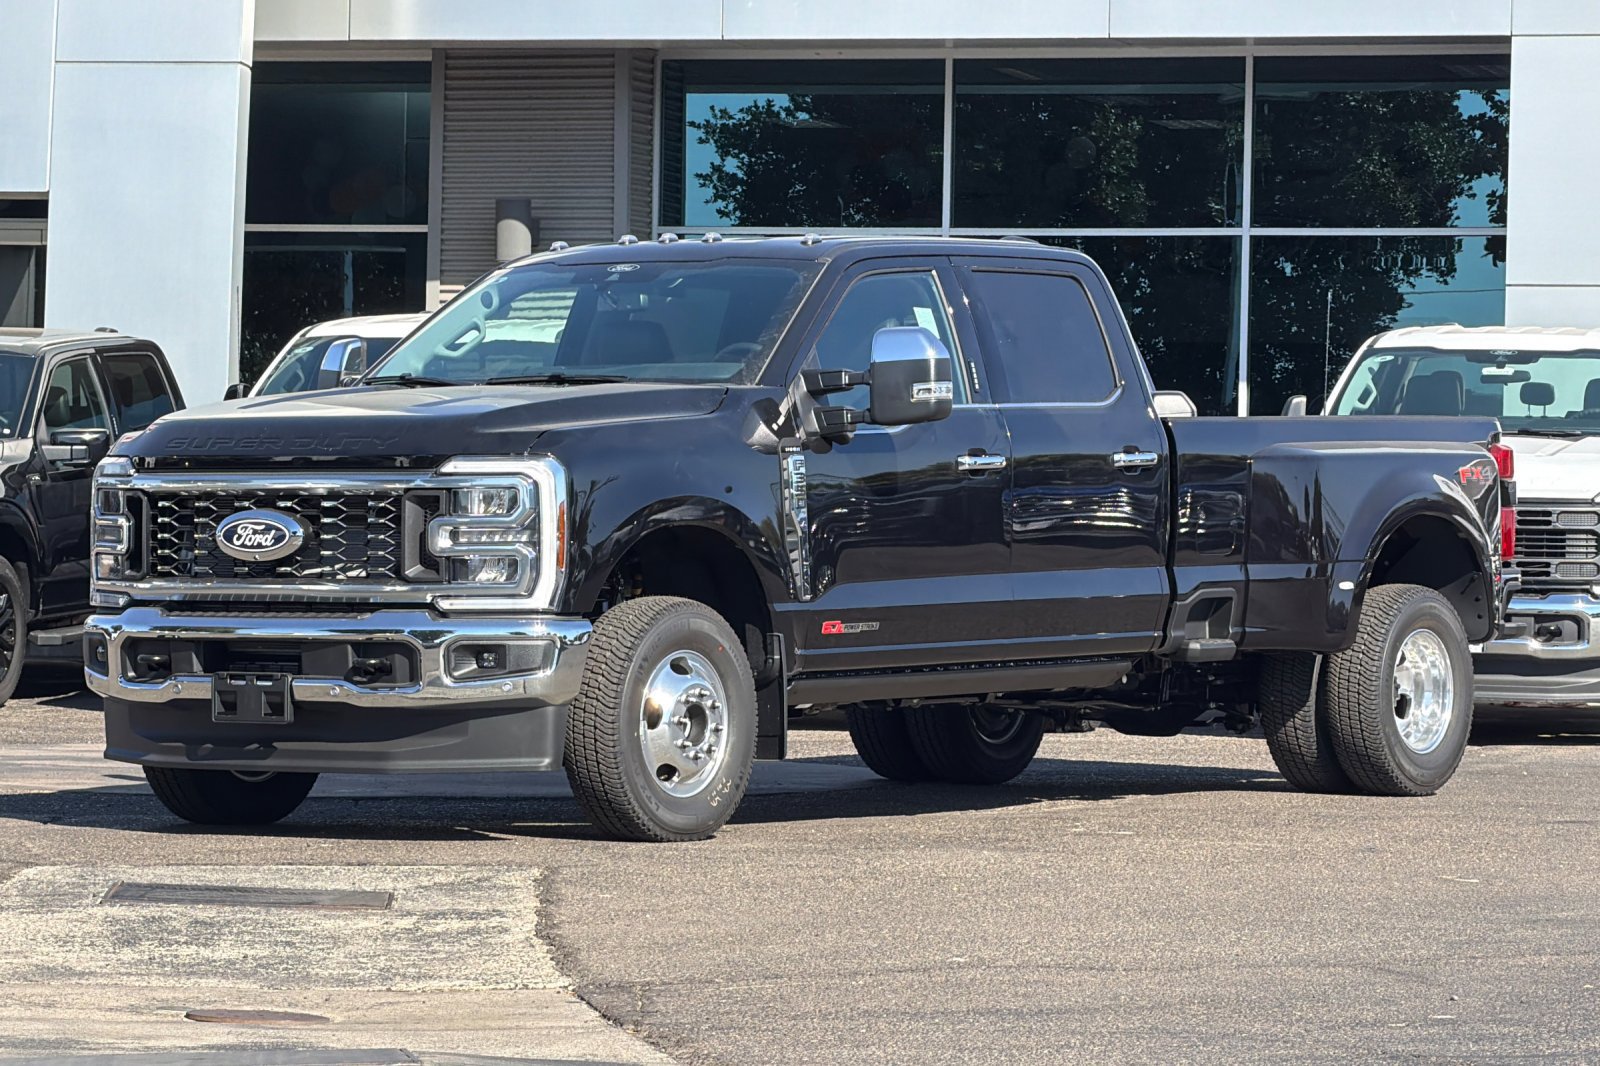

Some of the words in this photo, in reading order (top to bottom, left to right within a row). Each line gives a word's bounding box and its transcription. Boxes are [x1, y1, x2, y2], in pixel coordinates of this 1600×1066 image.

[166, 436, 285, 451] SUPER
[289, 436, 399, 450] DUTY
[1458, 465, 1492, 485] FX4
[233, 523, 276, 547] Ford
